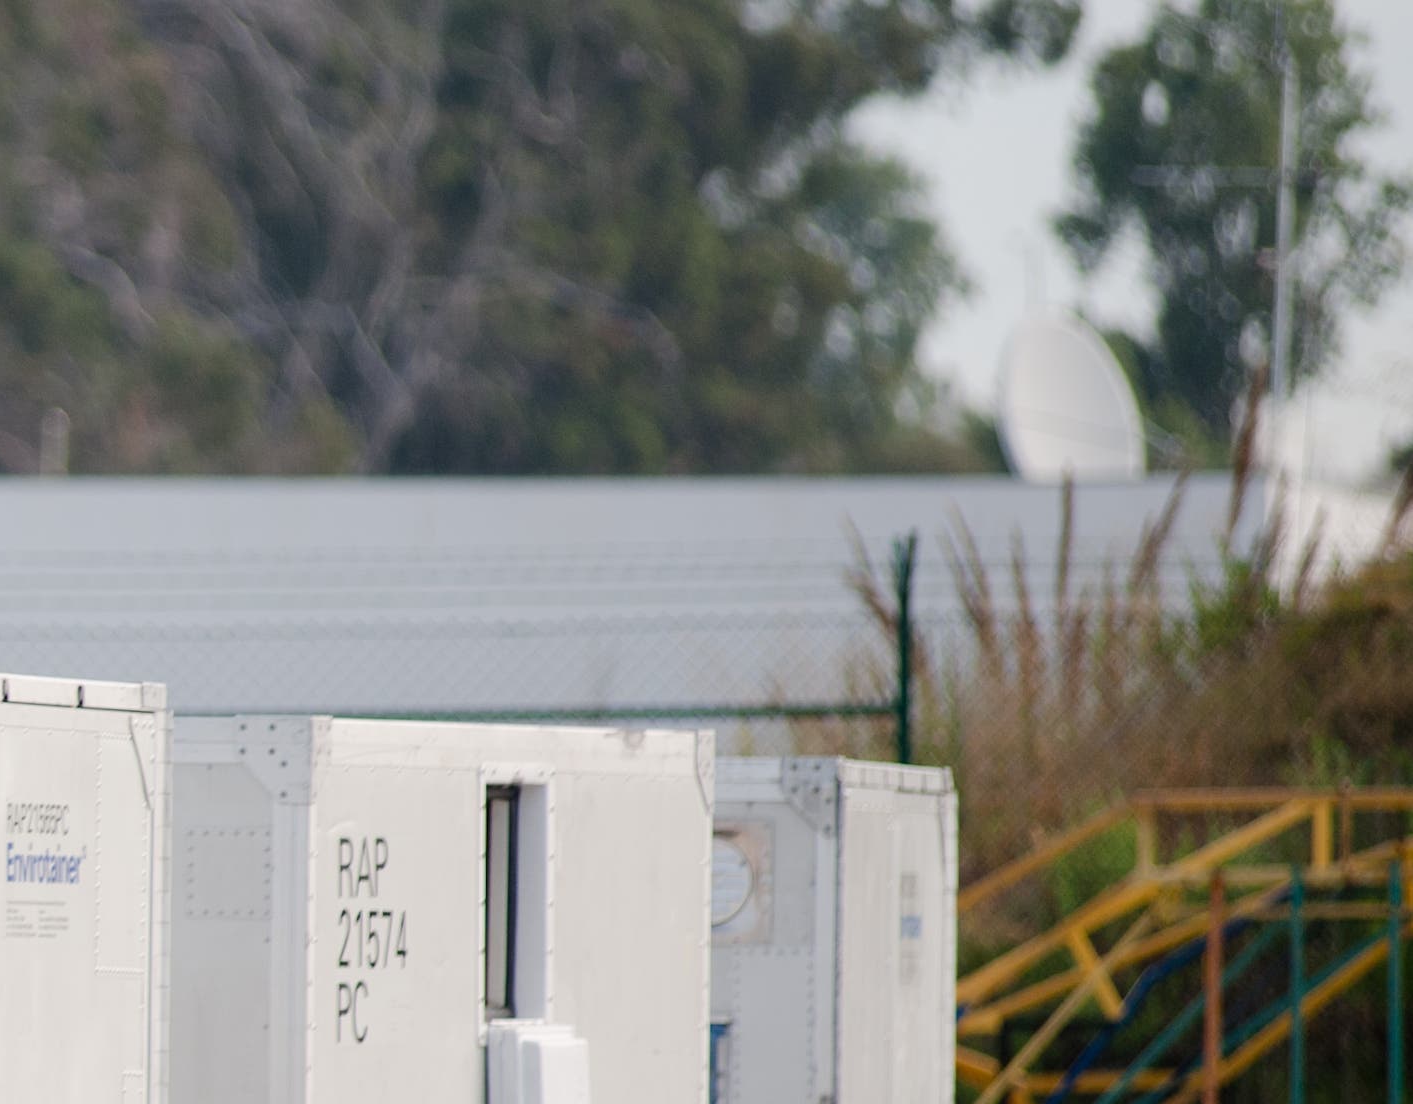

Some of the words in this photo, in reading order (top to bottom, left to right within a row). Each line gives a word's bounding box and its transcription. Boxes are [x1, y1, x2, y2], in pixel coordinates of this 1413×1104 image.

[337, 837, 389, 898] RAP
[337, 910, 407, 969] 21574
[337, 980, 369, 1044] PC
